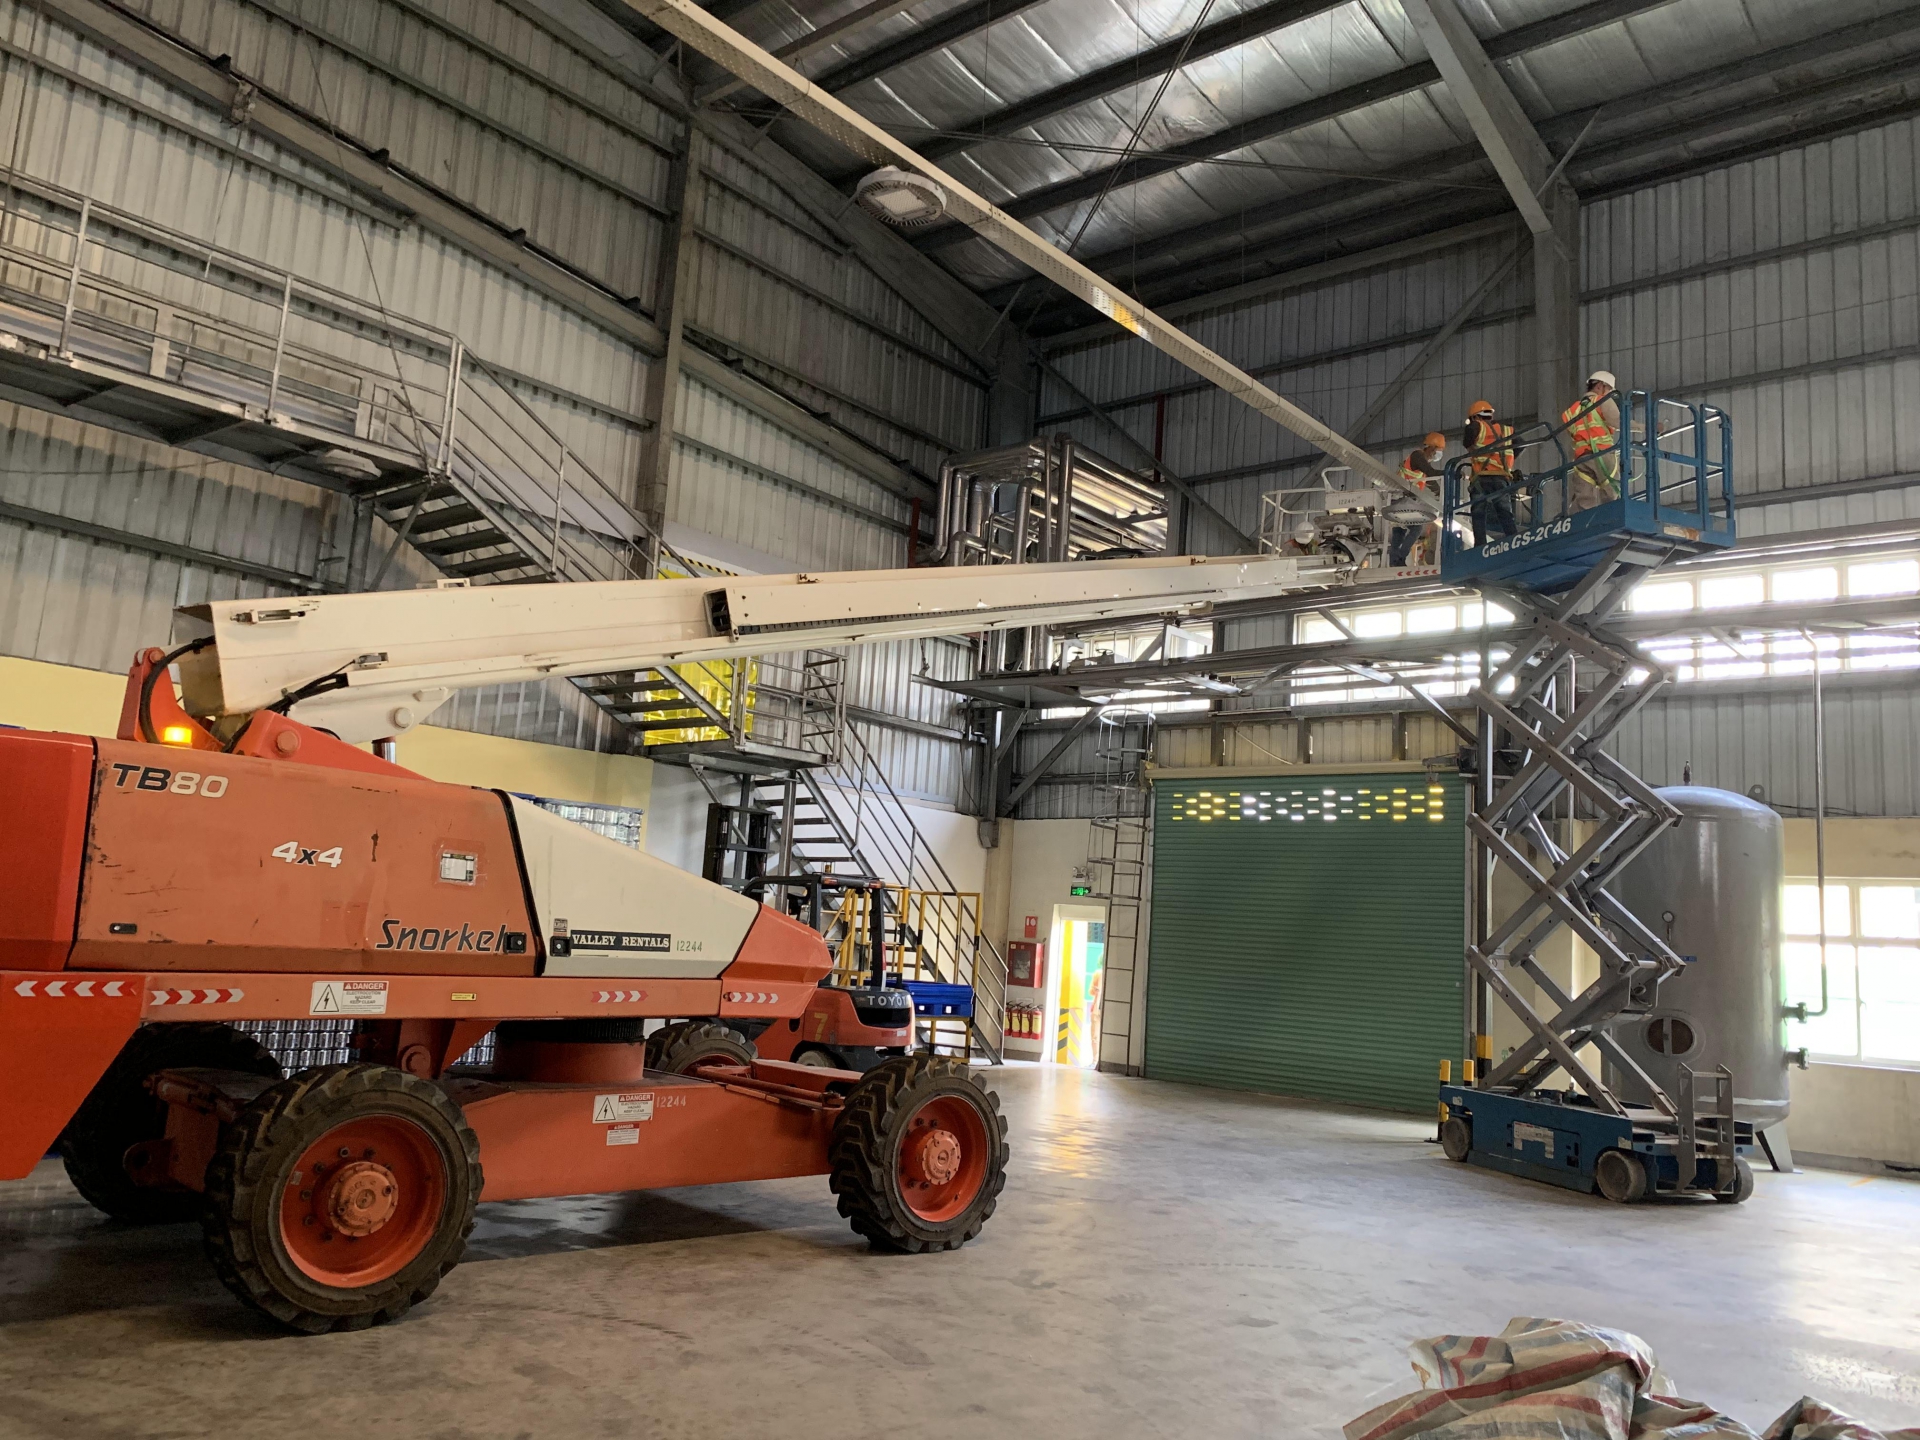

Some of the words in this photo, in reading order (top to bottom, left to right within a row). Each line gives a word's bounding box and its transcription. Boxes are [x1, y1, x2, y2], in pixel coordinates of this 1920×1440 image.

[1482, 541, 1510, 558] Genie
[112, 762, 229, 799] TB80
[271, 841, 343, 868] 4x4
[375, 918, 508, 954] Snorkel
[572, 933, 616, 947] VALLEY
[621, 936, 670, 948] RENTALS
[676, 940, 703, 952] 12244
[352, 982, 384, 990] DANGER
[867, 995, 908, 1006] TOYOT
[814, 1012, 828, 1042] 7
[656, 1095, 686, 1108] 12244
